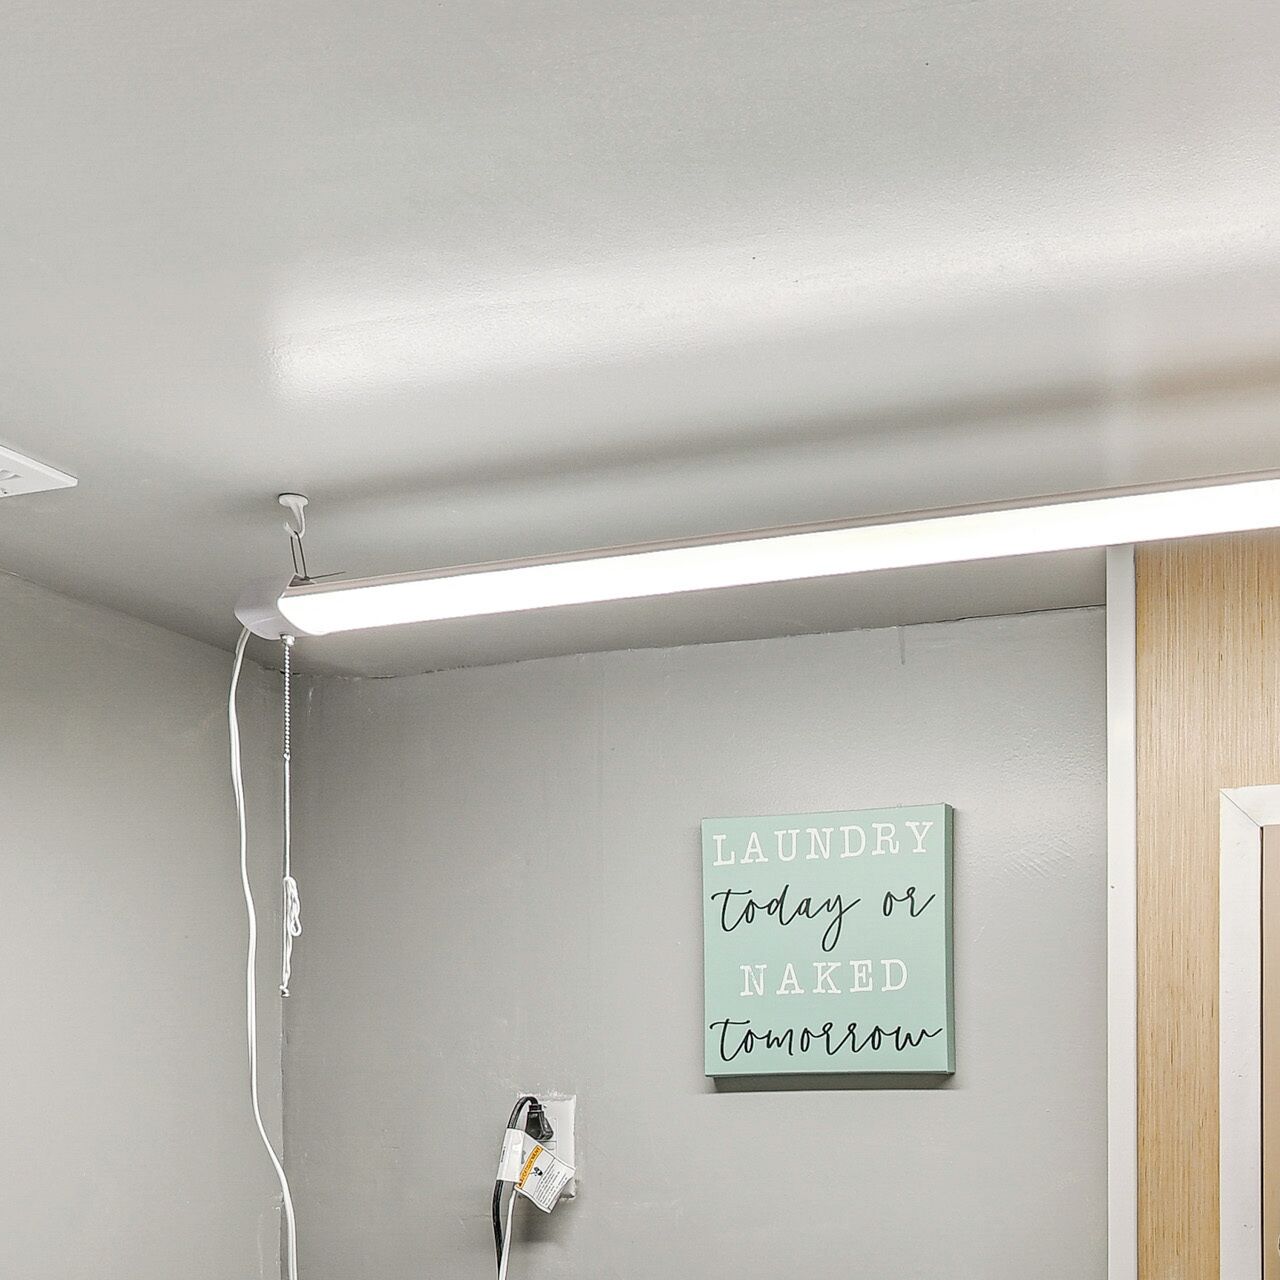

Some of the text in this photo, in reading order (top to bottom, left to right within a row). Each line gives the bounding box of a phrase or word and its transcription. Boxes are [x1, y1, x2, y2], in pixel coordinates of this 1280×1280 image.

[712, 821, 934, 866] LAUNDRY
[711, 884, 935, 952] today or
[739, 958, 908, 997] NAKED
[709, 1018, 943, 1062] tomorrow
